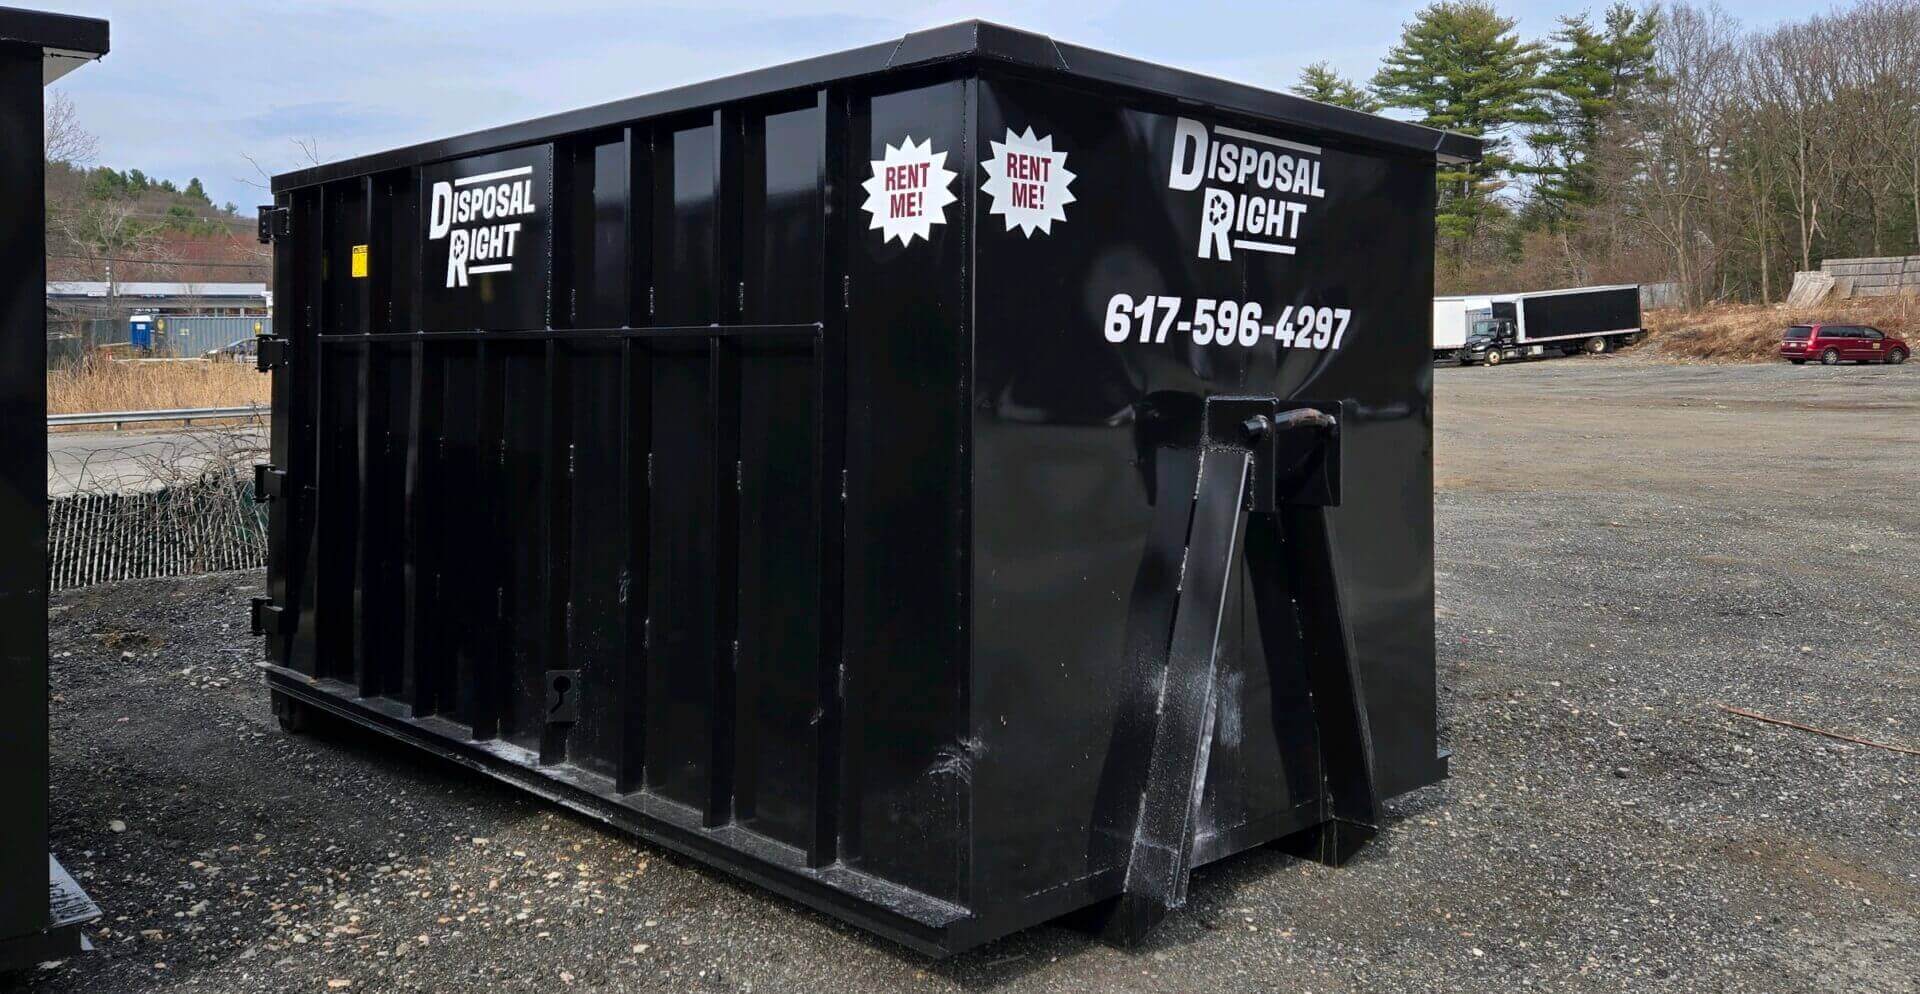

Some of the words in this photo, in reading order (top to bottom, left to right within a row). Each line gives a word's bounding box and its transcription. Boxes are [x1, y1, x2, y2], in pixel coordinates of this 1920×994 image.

[885, 162, 930, 192] RENT
[1006, 152, 1052, 183] RENT
[1168, 117, 1325, 198] DISPOSAL
[429, 179, 535, 240] DISPOSAL
[890, 191, 923, 218] ME!
[1012, 182, 1045, 210] ME!
[1198, 186, 1307, 262] RIGHT
[446, 222, 521, 288] RIGHT
[1104, 293, 1352, 350] 617-596-4297
